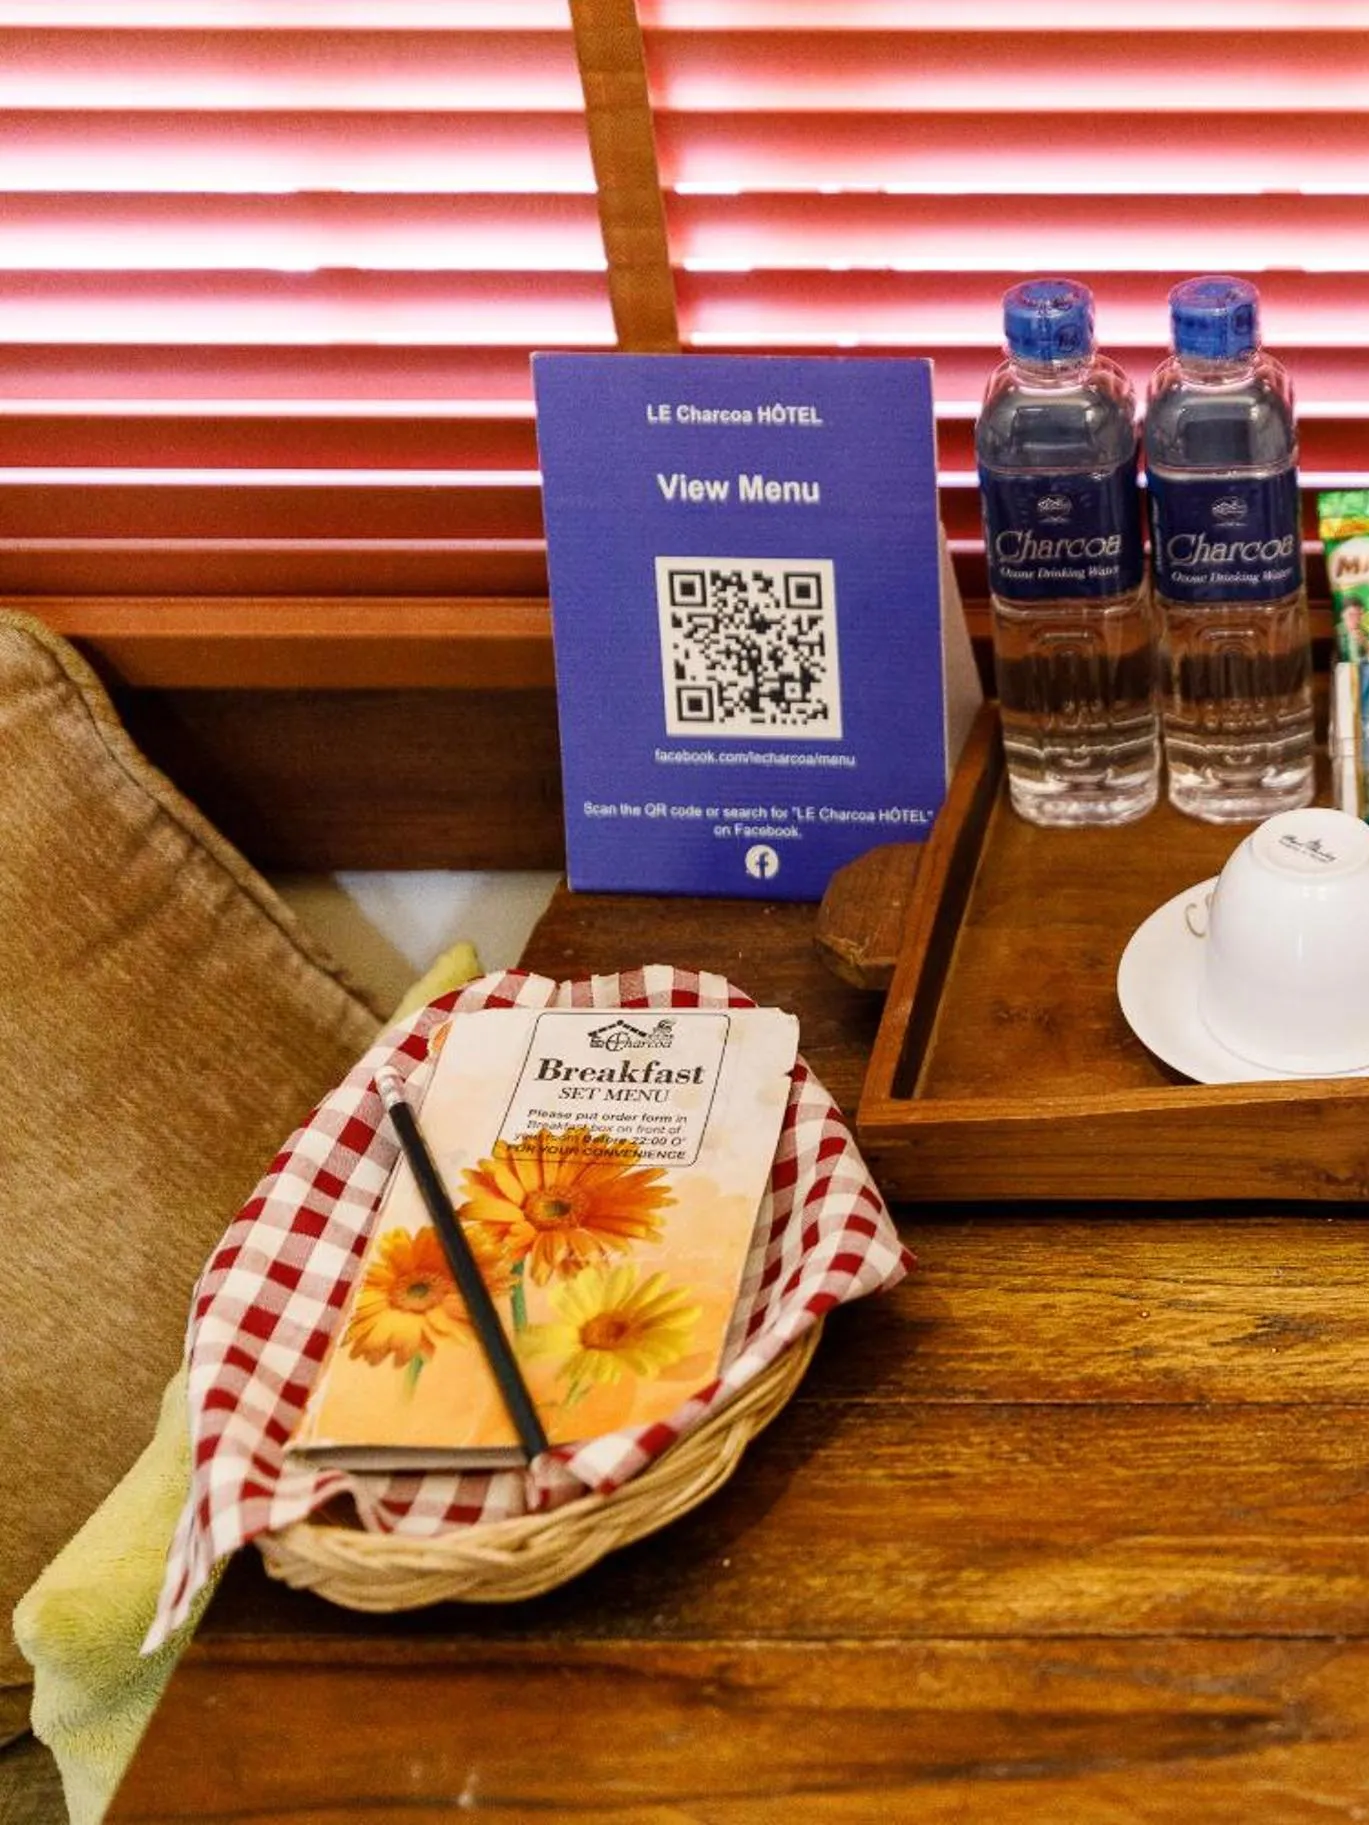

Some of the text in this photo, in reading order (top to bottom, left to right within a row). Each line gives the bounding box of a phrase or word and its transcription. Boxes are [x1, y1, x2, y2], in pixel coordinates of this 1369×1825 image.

[647, 404, 824, 426] LE Charcoa HÔTEL
[656, 473, 820, 503] View Menu
[996, 529, 1122, 563] Charcoa
[1167, 532, 1294, 566] Charcoa
[1037, 566, 1087, 580] Drinking
[583, 801, 618, 818] Scan
[619, 803, 641, 818] the
[644, 803, 668, 818] QR
[670, 805, 703, 818] code
[706, 807, 720, 819] or
[723, 805, 768, 820] search
[771, 806, 788, 820] for
[818, 808, 876, 822] Charcoa
[713, 824, 732, 838] on
[533, 1057, 706, 1086] Breakfast
[557, 1087, 671, 1103] SET MENU
[527, 1108, 688, 1123] Please put order form in
[590, 1123, 613, 1133] box
[636, 1125, 667, 1134] front
[668, 1125, 682, 1134] of
[583, 1133, 628, 1145] Before
[538, 1145, 580, 1156] YOUR
[582, 1147, 687, 1160] CONVENIENCE
